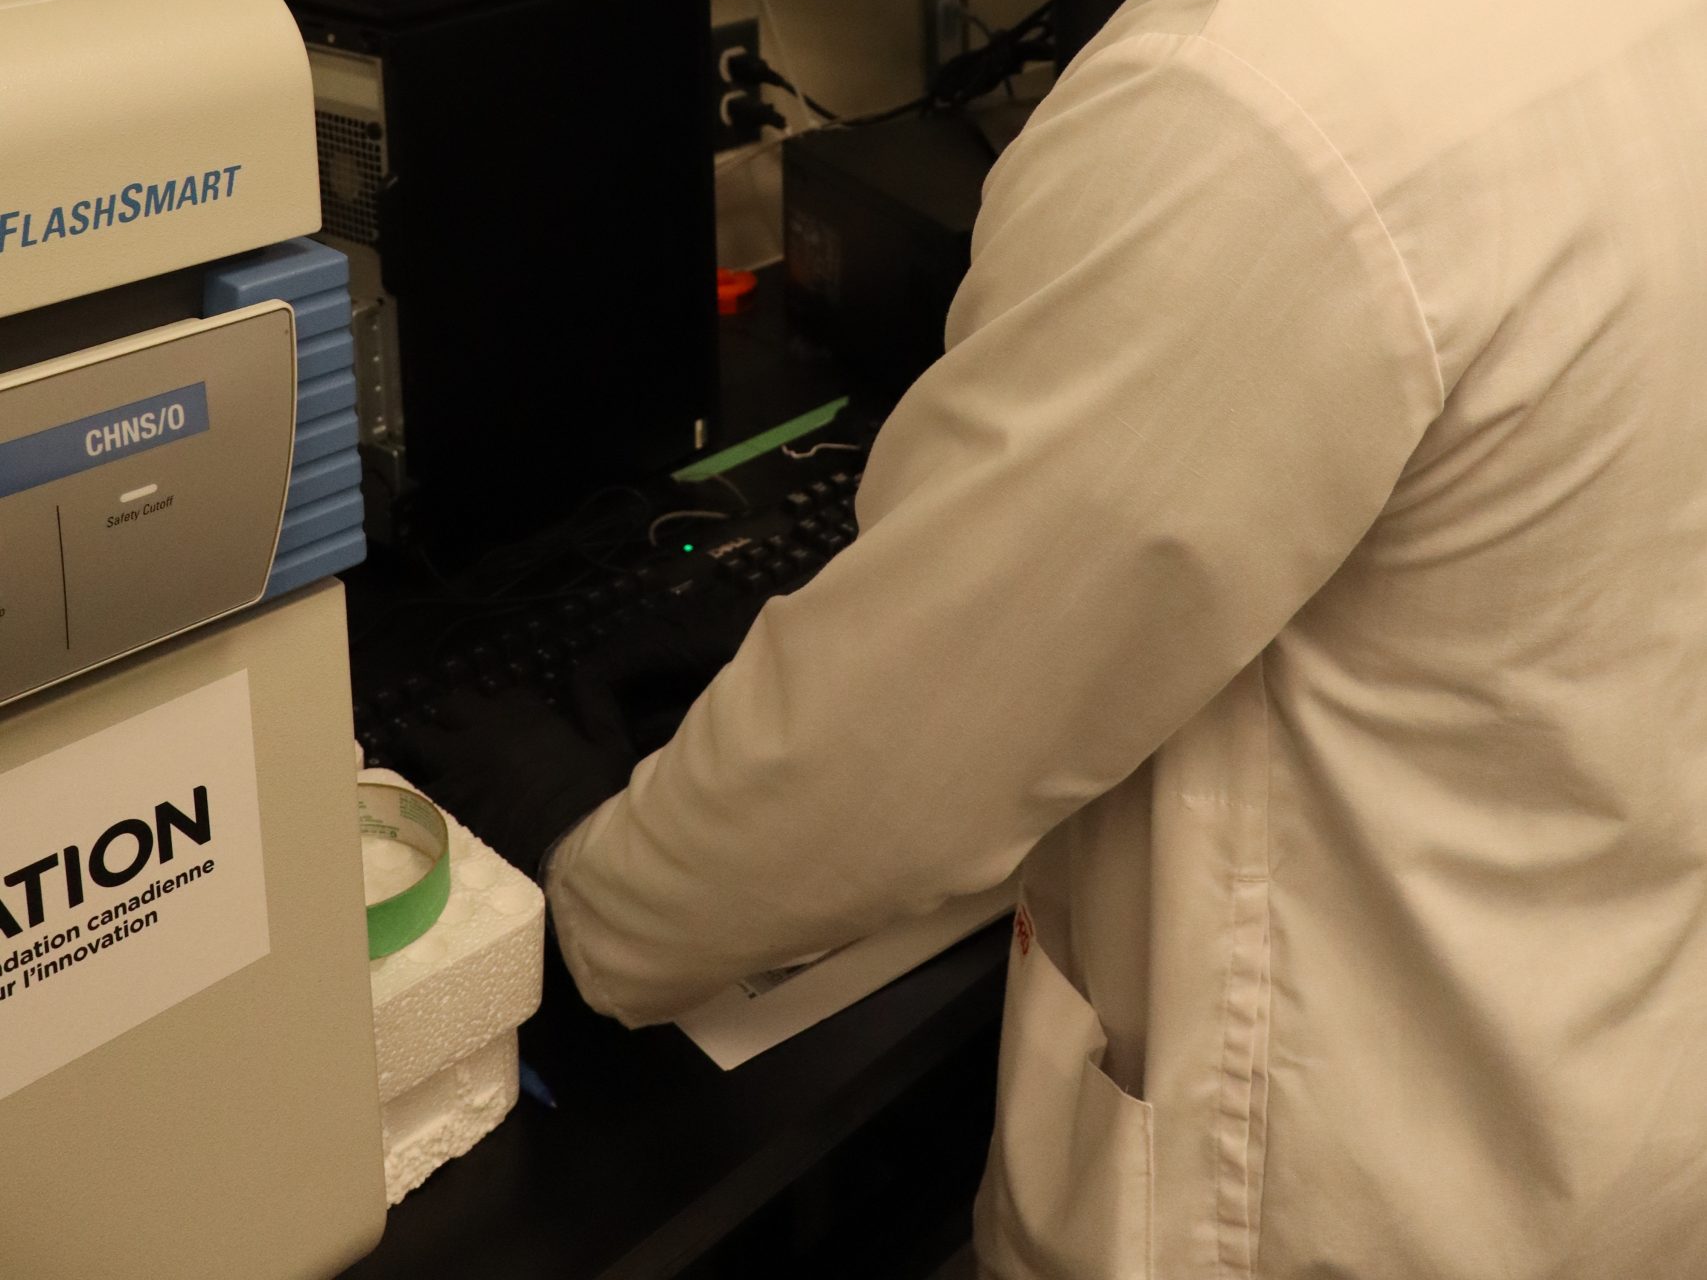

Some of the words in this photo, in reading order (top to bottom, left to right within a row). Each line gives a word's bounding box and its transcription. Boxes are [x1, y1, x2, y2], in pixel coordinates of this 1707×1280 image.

[0, 165, 242, 252] FLASHSMART
[106, 509, 140, 529] Safety
[142, 494, 175, 517] Cutoff
[87, 858, 215, 932] canadienne
